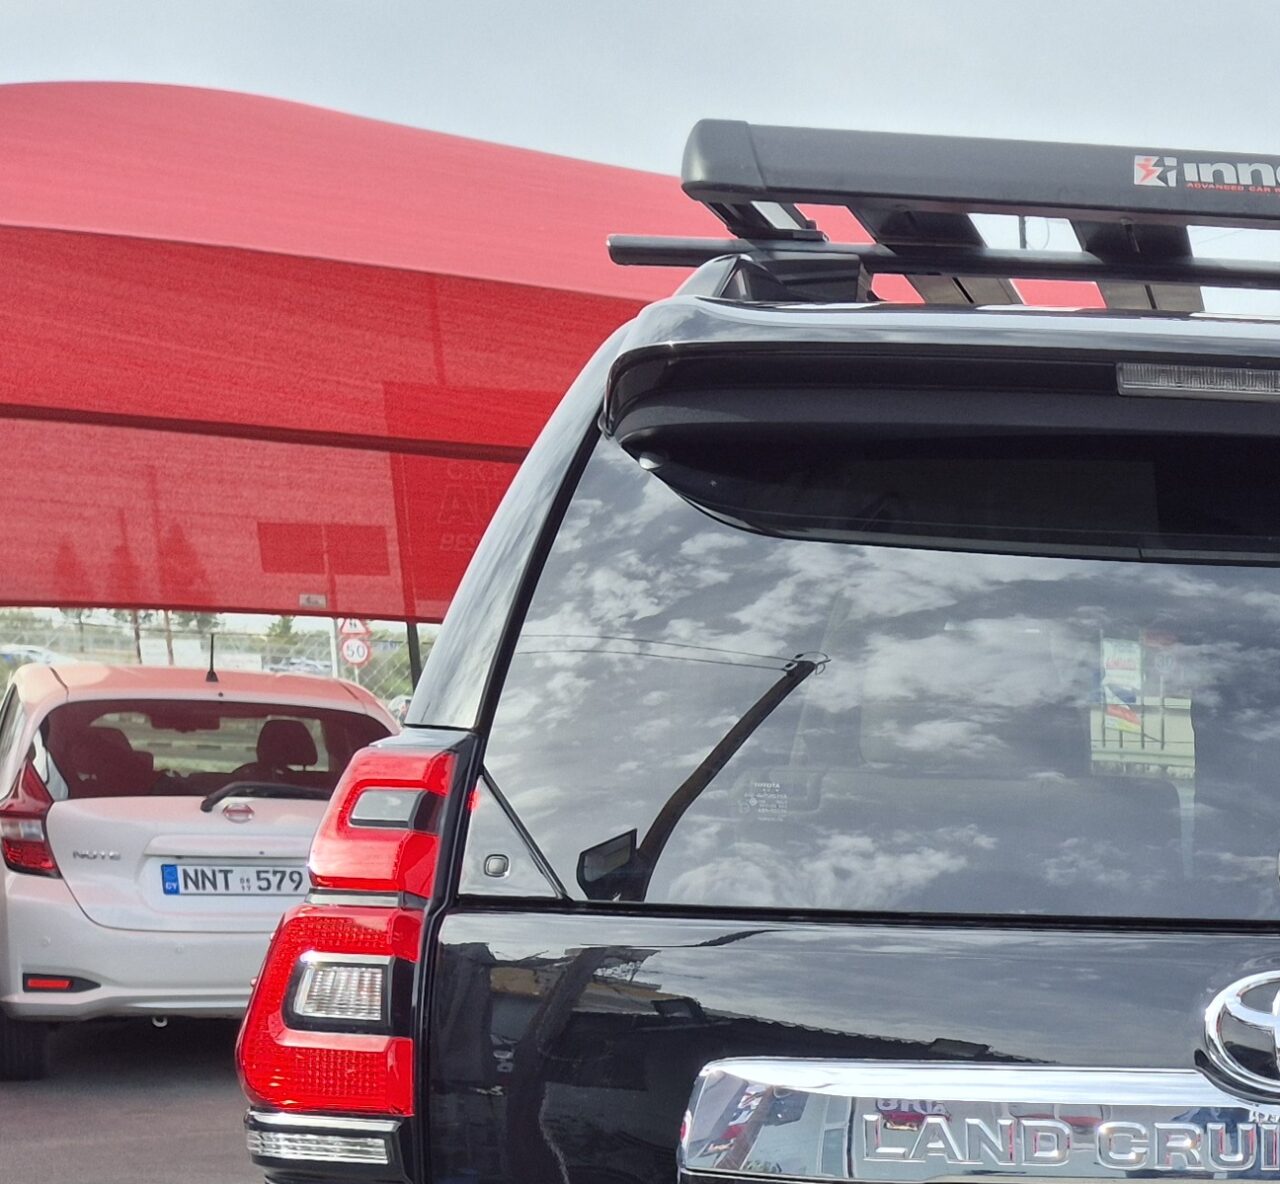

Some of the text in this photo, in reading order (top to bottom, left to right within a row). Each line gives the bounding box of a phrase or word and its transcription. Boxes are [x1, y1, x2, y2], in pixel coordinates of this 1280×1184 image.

[1186, 182, 1245, 192] ADVANCED
[1248, 185, 1272, 193] CAR
[346, 644, 366, 658] 50
[182, 868, 234, 891] NNT
[255, 869, 304, 892] 579
[862, 1113, 1071, 1166] LAND
